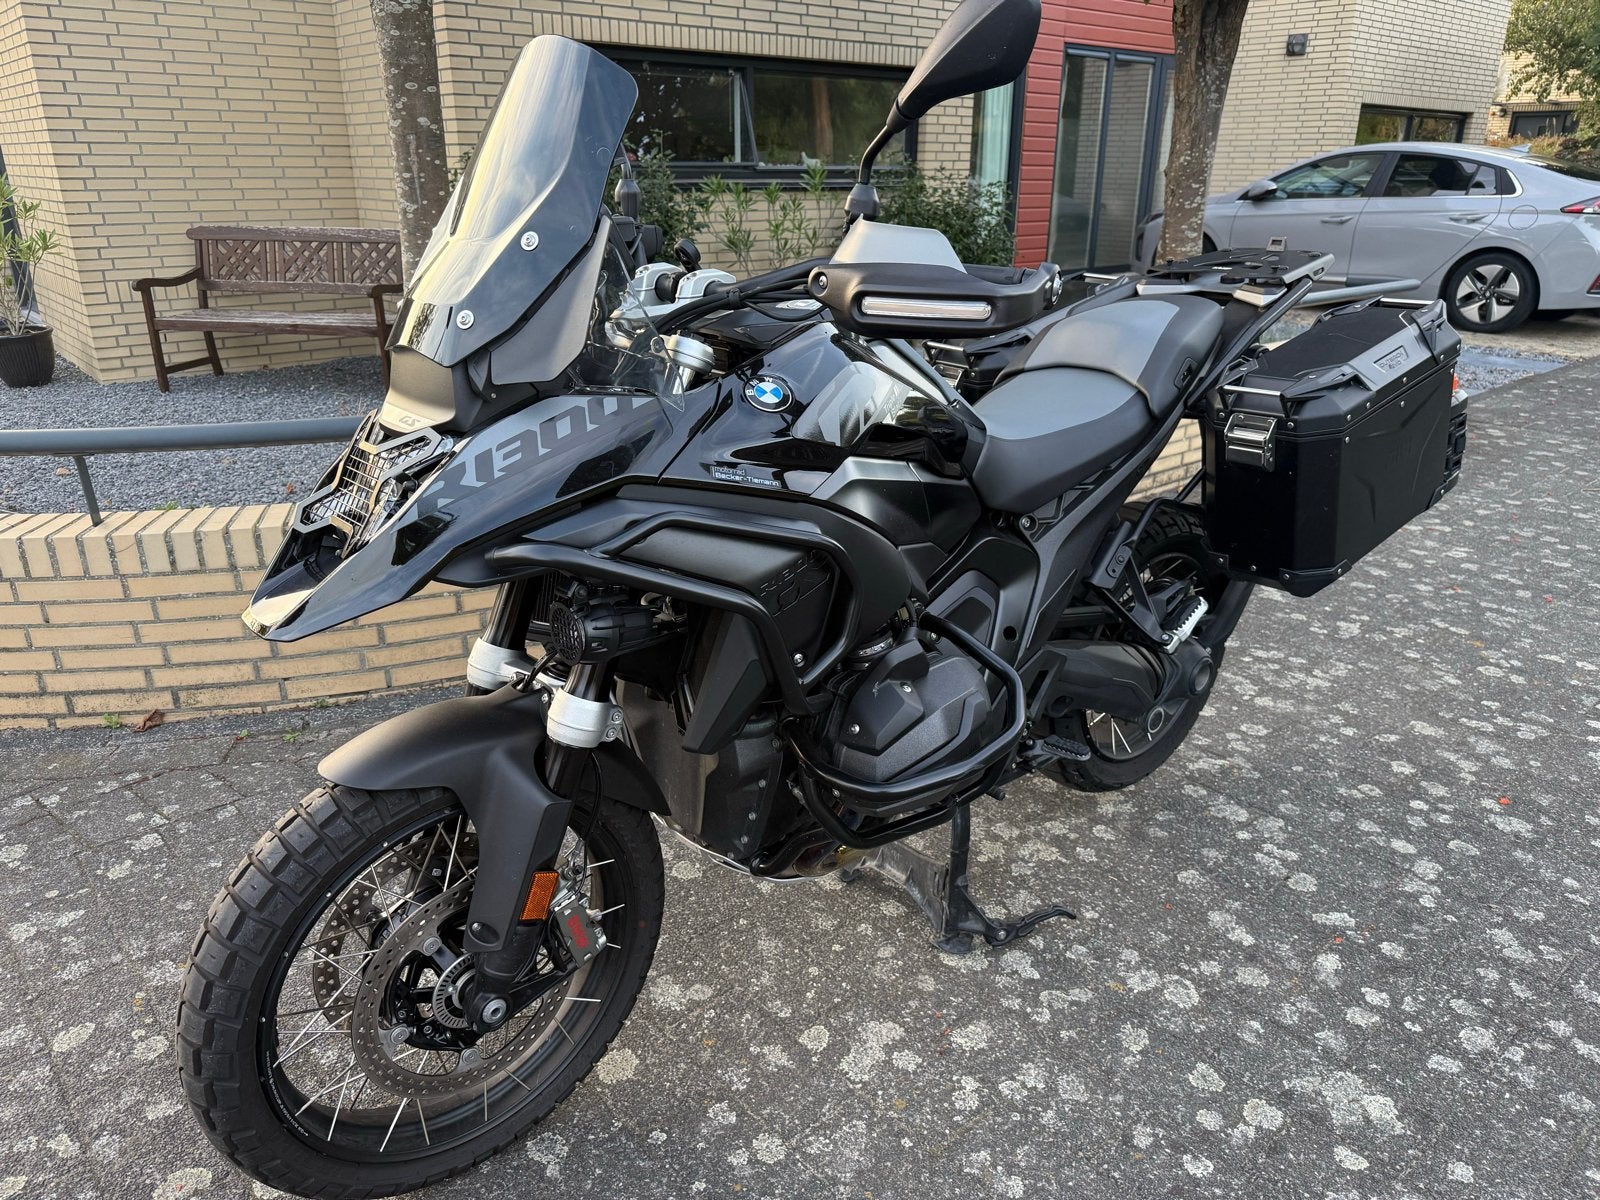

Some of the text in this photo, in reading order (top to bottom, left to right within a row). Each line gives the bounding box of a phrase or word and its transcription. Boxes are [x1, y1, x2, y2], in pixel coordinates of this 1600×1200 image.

[399, 416, 421, 427] GS
[714, 466, 745, 475] motorrad
[715, 472, 779, 487] Becker-Tiemann
